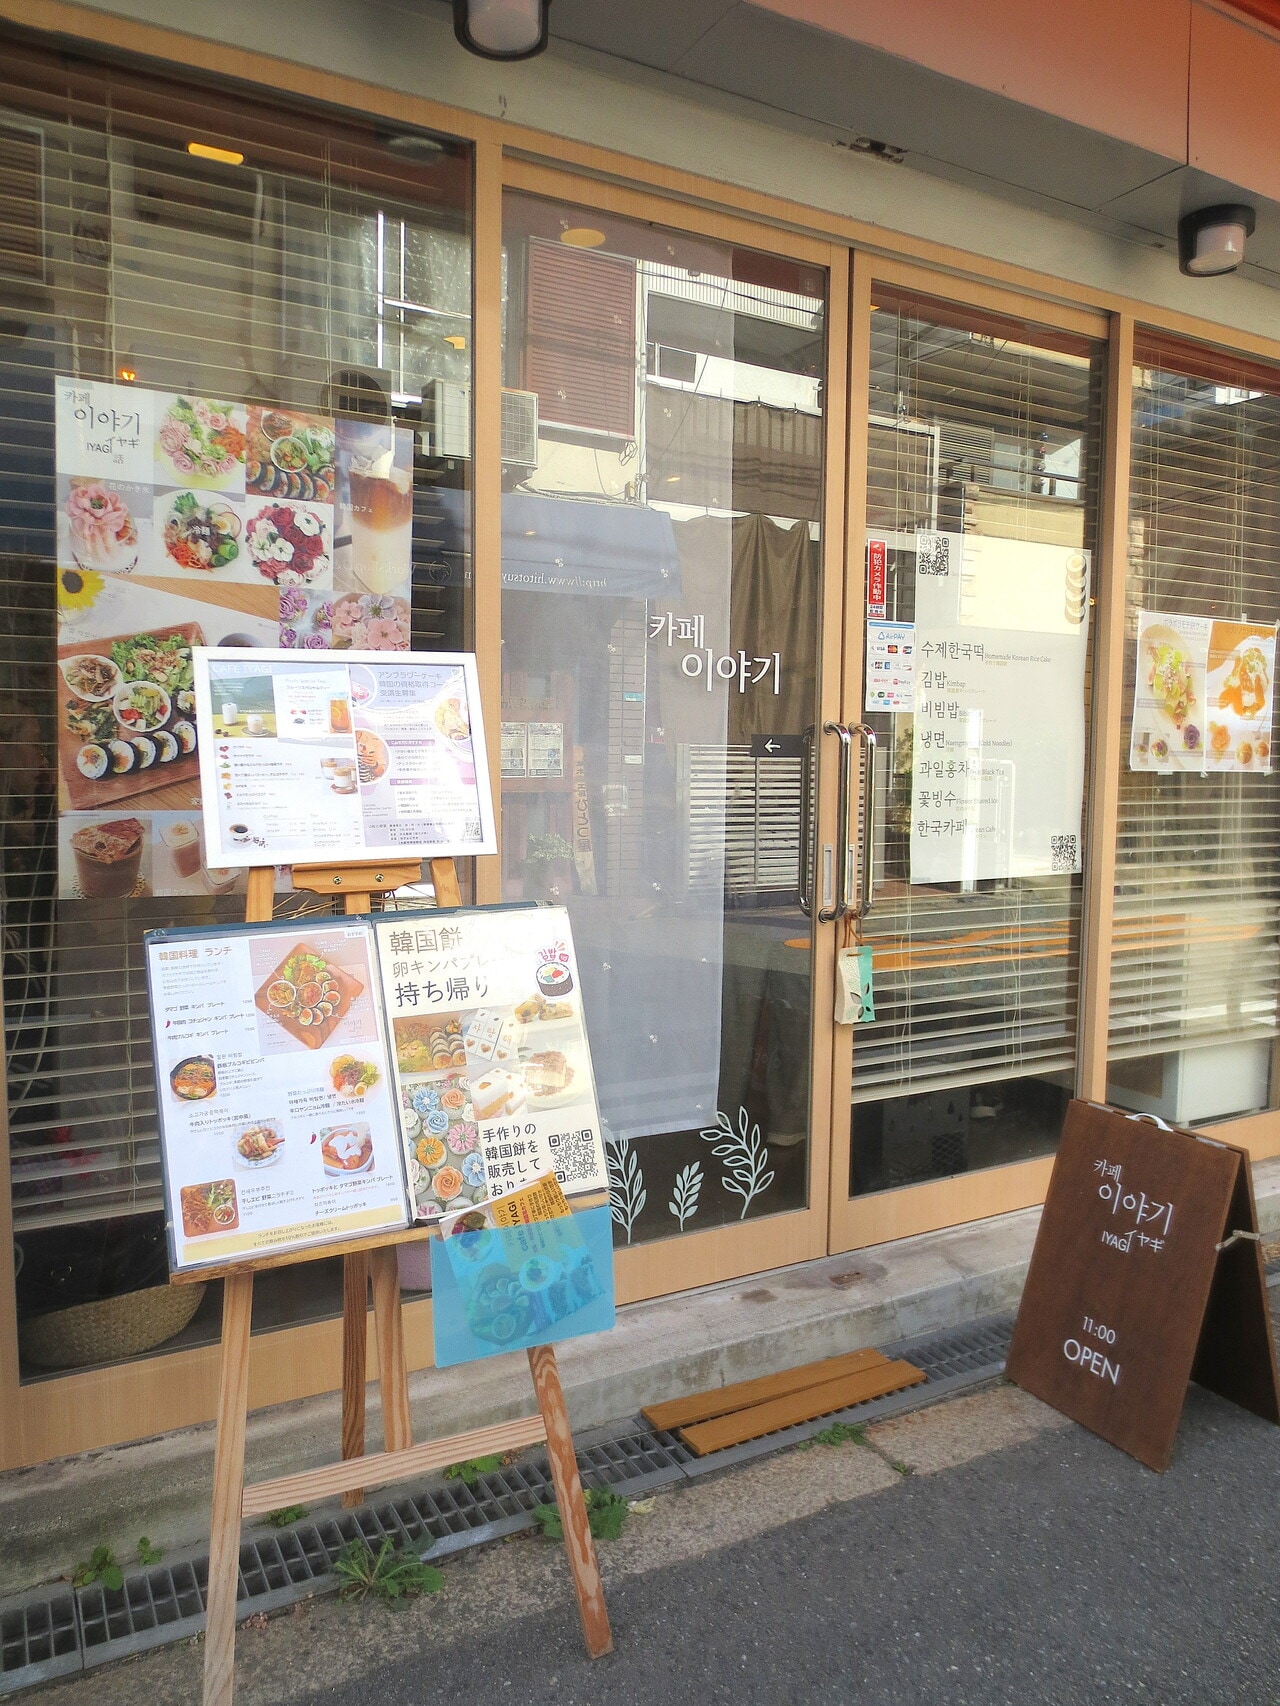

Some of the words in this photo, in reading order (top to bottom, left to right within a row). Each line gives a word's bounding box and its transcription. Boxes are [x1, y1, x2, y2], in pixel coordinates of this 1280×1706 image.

[64, 389, 91, 404] 카페
[74, 405, 140, 436] 이야기
[108, 482, 150, 493] 花のかき氷
[339, 502, 373, 513] 韓国カフェ
[872, 553, 882, 600] 防犯カメラ作動中
[649, 611, 705, 649] 카페
[920, 640, 984, 661] 수제한국떡
[984, 652, 1011, 660] Homemade
[212, 664, 240, 673] CAFE
[243, 664, 273, 673] IYAGI
[681, 648, 781, 695] 이야기
[921, 670, 947, 689] 김밥
[947, 680, 966, 688] Kimbap
[379, 689, 417, 697] 受講生募集
[921, 700, 960, 719] 비빔밥
[920, 730, 945, 749] 냉면
[918, 760, 970, 779] 과일홍차
[918, 790, 957, 808] 꽃빙수
[917, 818, 968, 837] 한국카페
[388, 926, 463, 956] 韓国餅
[158, 948, 199, 962] 韓国料理
[204, 945, 233, 959] ランチ
[537, 947, 558, 960] 김밥
[395, 975, 488, 1008] 持ち帰り
[164, 1005, 178, 1013] タマゴ
[207, 1001, 225, 1009] プレート
[229, 1012, 245, 1020] プレート
[211, 1029, 229, 1037] プレート
[482, 1123, 537, 1143] 手作りの
[485, 1139, 539, 1161] 韓国餅を
[487, 1157, 541, 1180] 販売して
[1093, 1159, 1122, 1183] 카페
[311, 1184, 339, 1194] トッポッキと
[376, 1175, 393, 1183] プレート
[241, 1195, 260, 1205] 干しエビ
[314, 1202, 367, 1216] チーズクリームトッポッキ
[1098, 1182, 1173, 1236] 이야기
[517, 1229, 529, 1252] cafe
[1083, 1316, 1116, 1345] 11:00
[1063, 1339, 1120, 1386] OPEN
